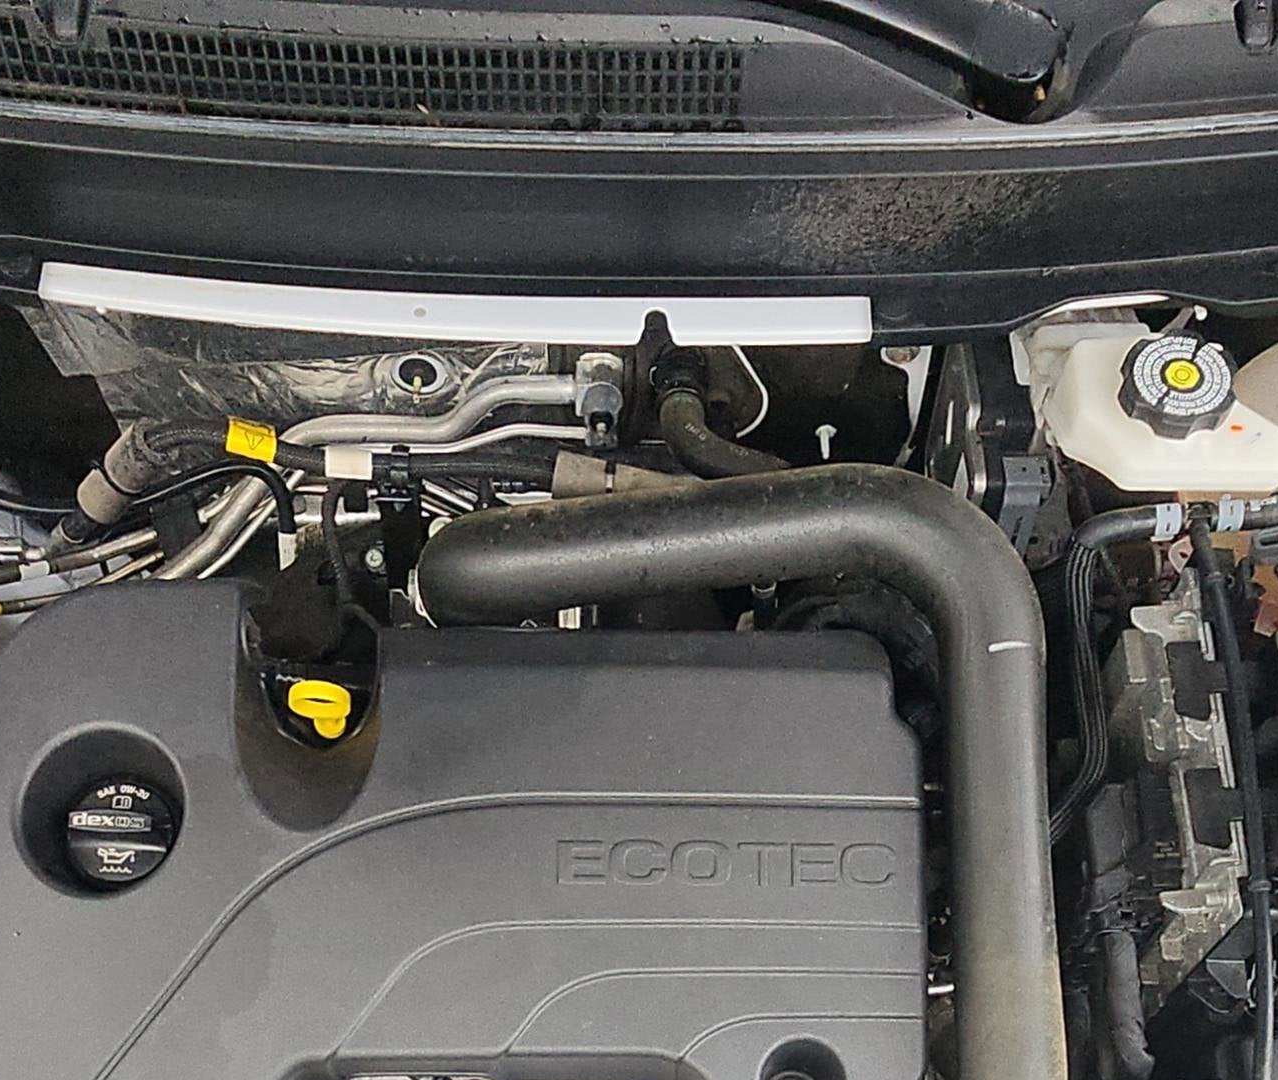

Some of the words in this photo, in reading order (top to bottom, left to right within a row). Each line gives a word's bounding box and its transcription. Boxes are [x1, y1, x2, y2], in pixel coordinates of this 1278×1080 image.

[97, 785, 117, 799] SAE
[119, 784, 151, 800] 0W-20
[72, 812, 146, 828] dexos
[555, 838, 897, 889] ECOTEC
